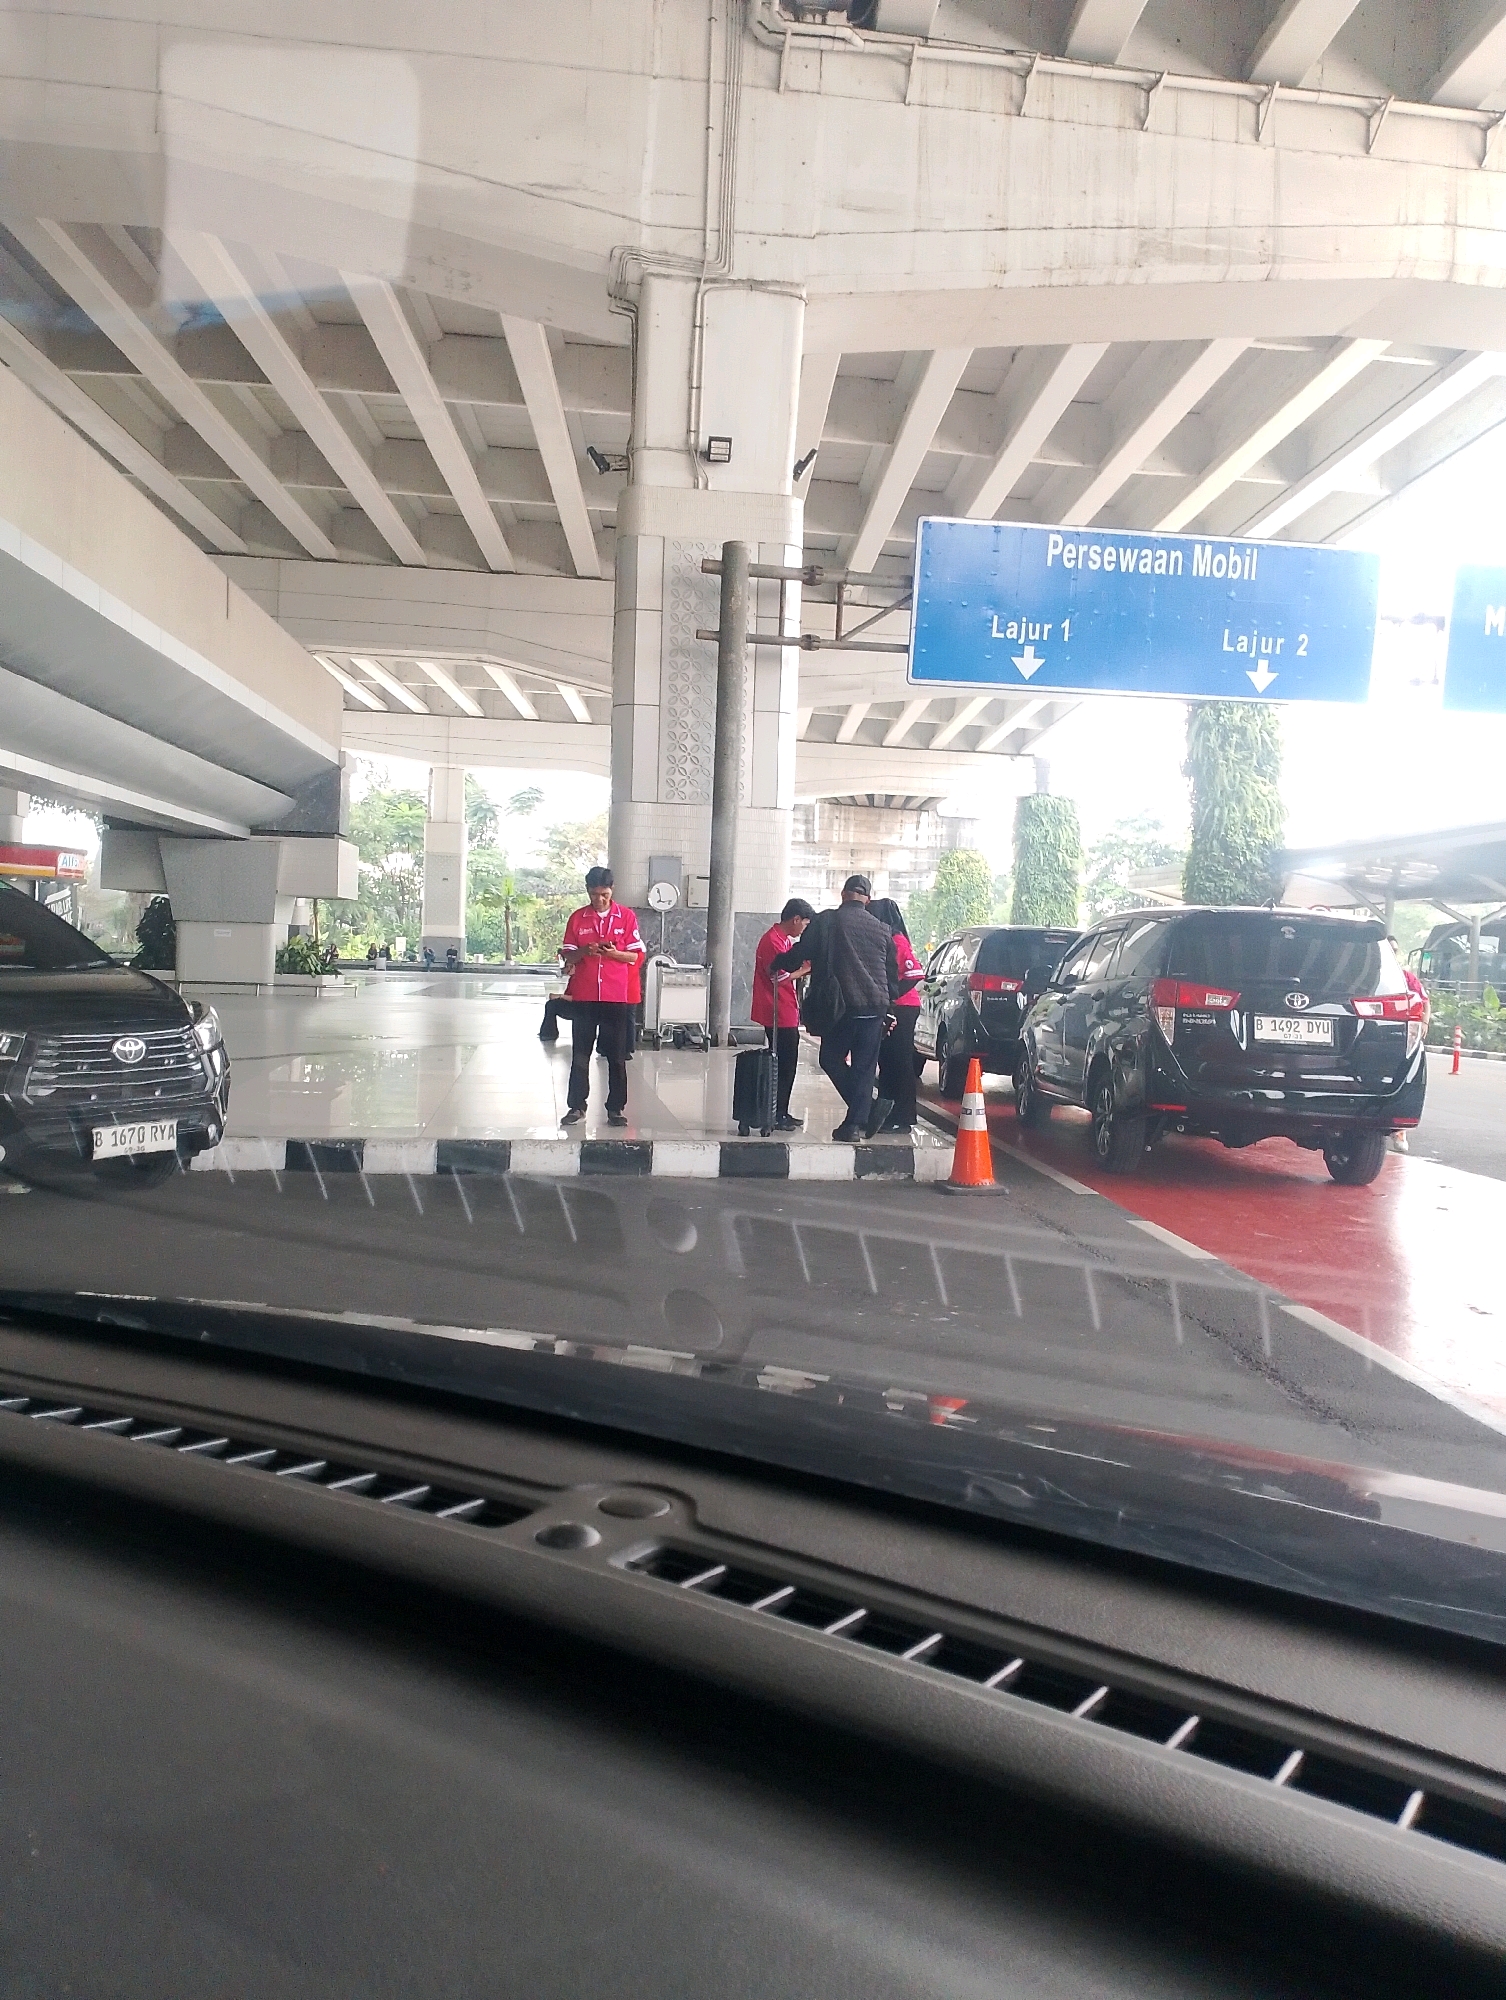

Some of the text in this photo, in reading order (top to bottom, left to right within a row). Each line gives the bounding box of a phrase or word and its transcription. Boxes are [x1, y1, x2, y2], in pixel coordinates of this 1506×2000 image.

[1046, 533, 1258, 581] Persewaan Mobil
[991, 614, 1070, 645] Lajur 1
[1222, 628, 1309, 658] Lajur 2
[1255, 1018, 1330, 1035] B 1492 DYU
[94, 1124, 175, 1148] B 1670 RYA
